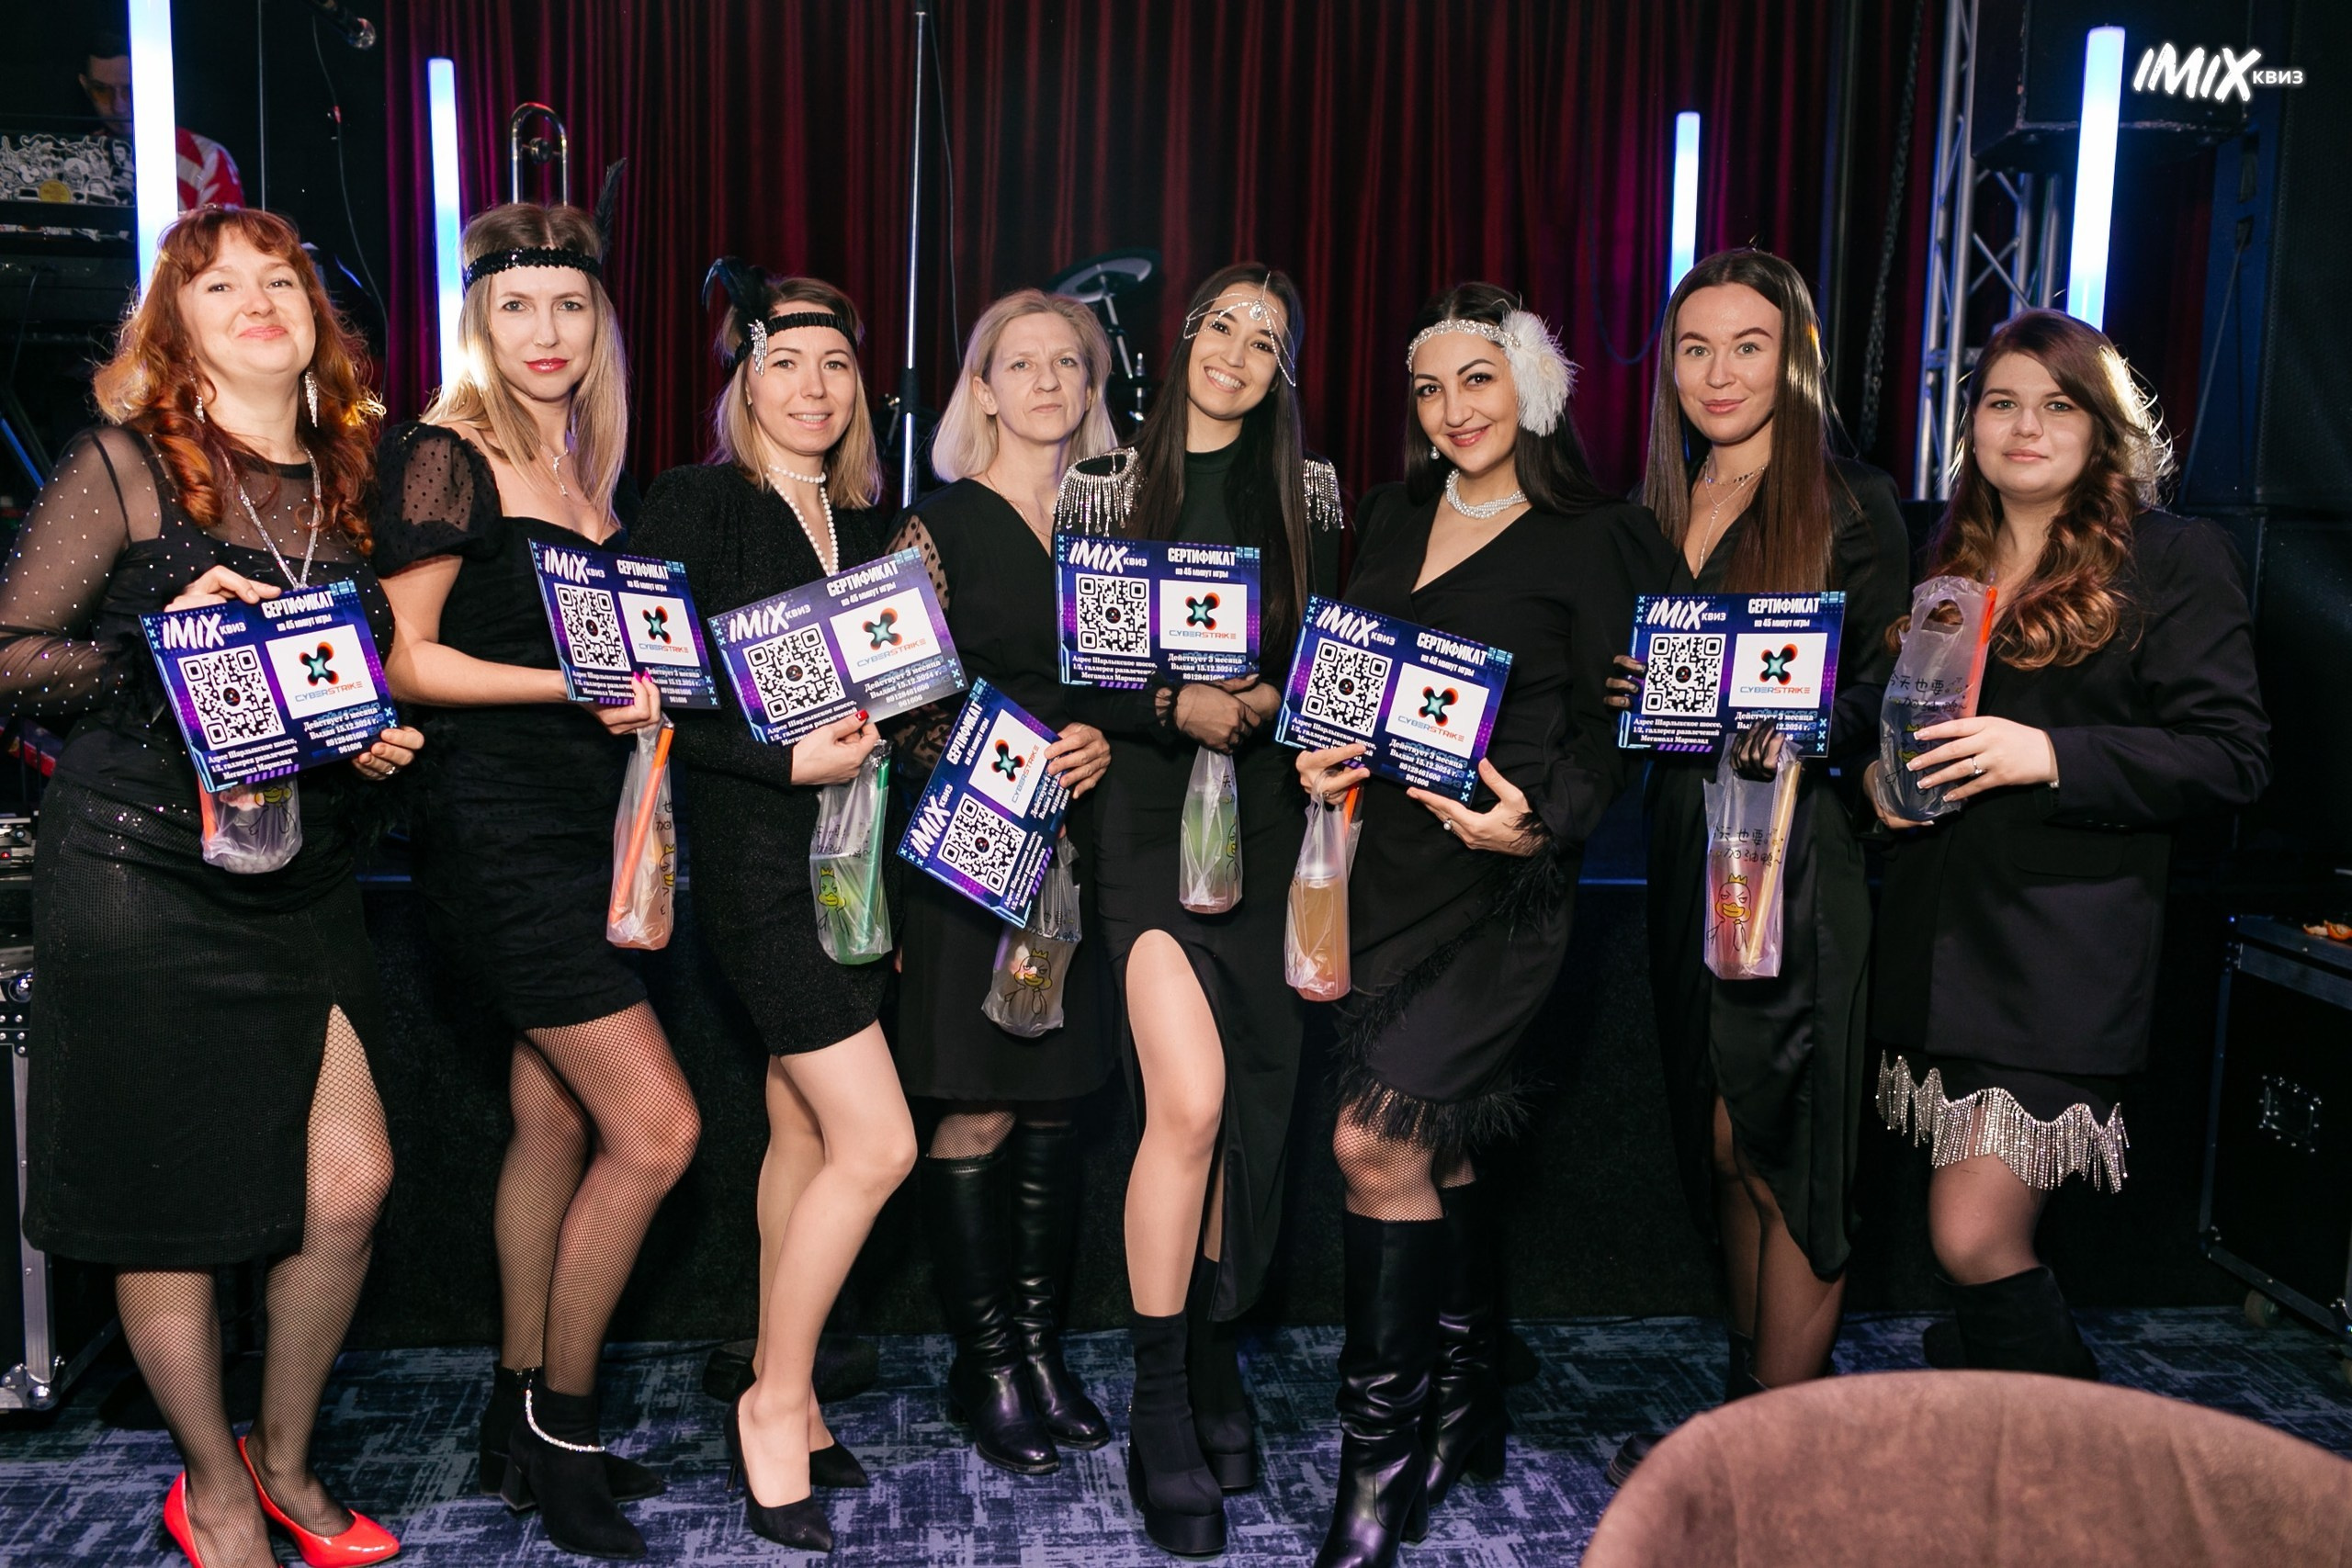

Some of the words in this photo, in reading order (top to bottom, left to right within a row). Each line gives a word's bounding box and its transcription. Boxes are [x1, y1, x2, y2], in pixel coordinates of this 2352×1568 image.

[617, 559, 669, 580] СЕРТИФИКАТ
[1069, 539, 1128, 573] IMIX
[1124, 558, 1147, 566] КВИЗ
[1169, 547, 1236, 566] СЕРТИФИКАТ
[827, 558, 899, 597] СЕРТИФИКАТ
[261, 591, 334, 618] СЕРТИФИКАТ
[1646, 597, 1708, 630] IMIX
[1702, 613, 1725, 621] КВИЗ
[1748, 598, 1822, 614] СЕРТИФИКАТ
[164, 614, 224, 649] IMIX
[220, 622, 246, 635] КВИЗ
[729, 602, 789, 642] IMIX
[785, 604, 810, 619] КВИЗ
[1170, 629, 1235, 640] CYBERSTRIKE
[1317, 604, 1379, 647] IMIX
[1371, 632, 1395, 645] КВИЗ
[856, 637, 926, 668] CYBERSTRIKE
[1417, 633, 1488, 665] СЕРТИФИКАТ
[904, 668, 911, 676] 3
[295, 681, 363, 704] CYBERSTRIKE
[1396, 715, 1464, 742] CYBERSTRIKE
[1776, 712, 1783, 720] 3
[946, 700, 982, 764] СЕРТИФИКАТ
[1011, 743, 1039, 804] CYBERSTRIKE
[910, 795, 951, 857] IMIX
